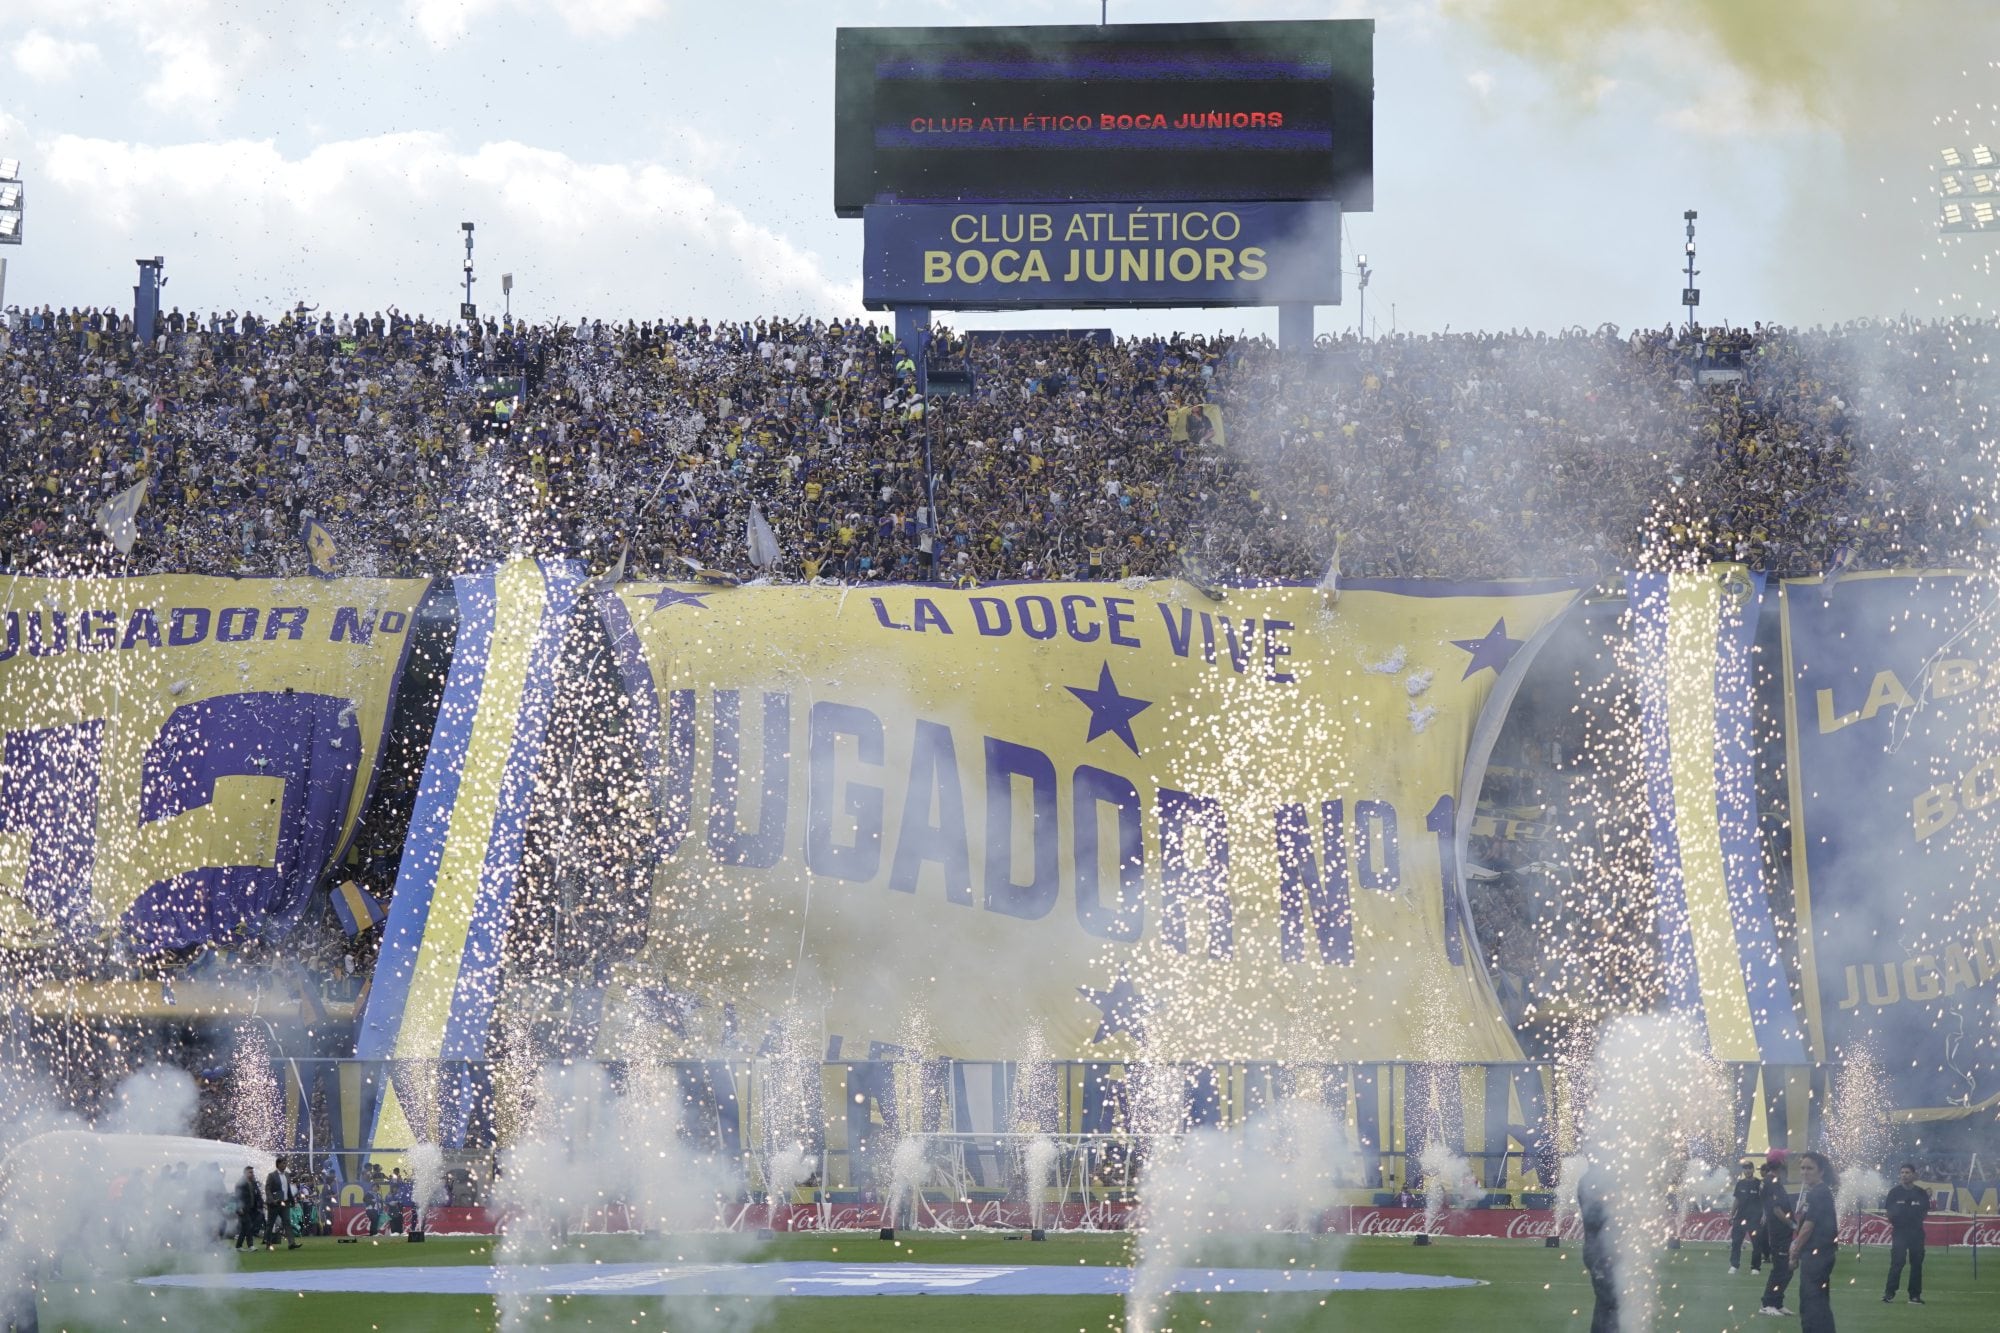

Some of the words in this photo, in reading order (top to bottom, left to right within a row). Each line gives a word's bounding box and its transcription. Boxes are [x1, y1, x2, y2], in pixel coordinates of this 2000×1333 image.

[911, 117, 973, 133] CLUB
[978, 113, 1093, 132] ATLÉTICO
[1100, 114, 1168, 130] BOCA
[1174, 112, 1284, 129] JUNIORS
[951, 214, 1053, 243] CLUB
[1064, 206, 1241, 242] ATLÉTICO
[924, 249, 1051, 284] BOCA
[1064, 247, 1268, 282] JUNIORS
[870, 597, 954, 635] LA
[968, 594, 1142, 649] DOCE
[1157, 601, 1297, 684] VIVE
[1816, 669, 1917, 735] LA
[655, 688, 1234, 967] JUGADOR
